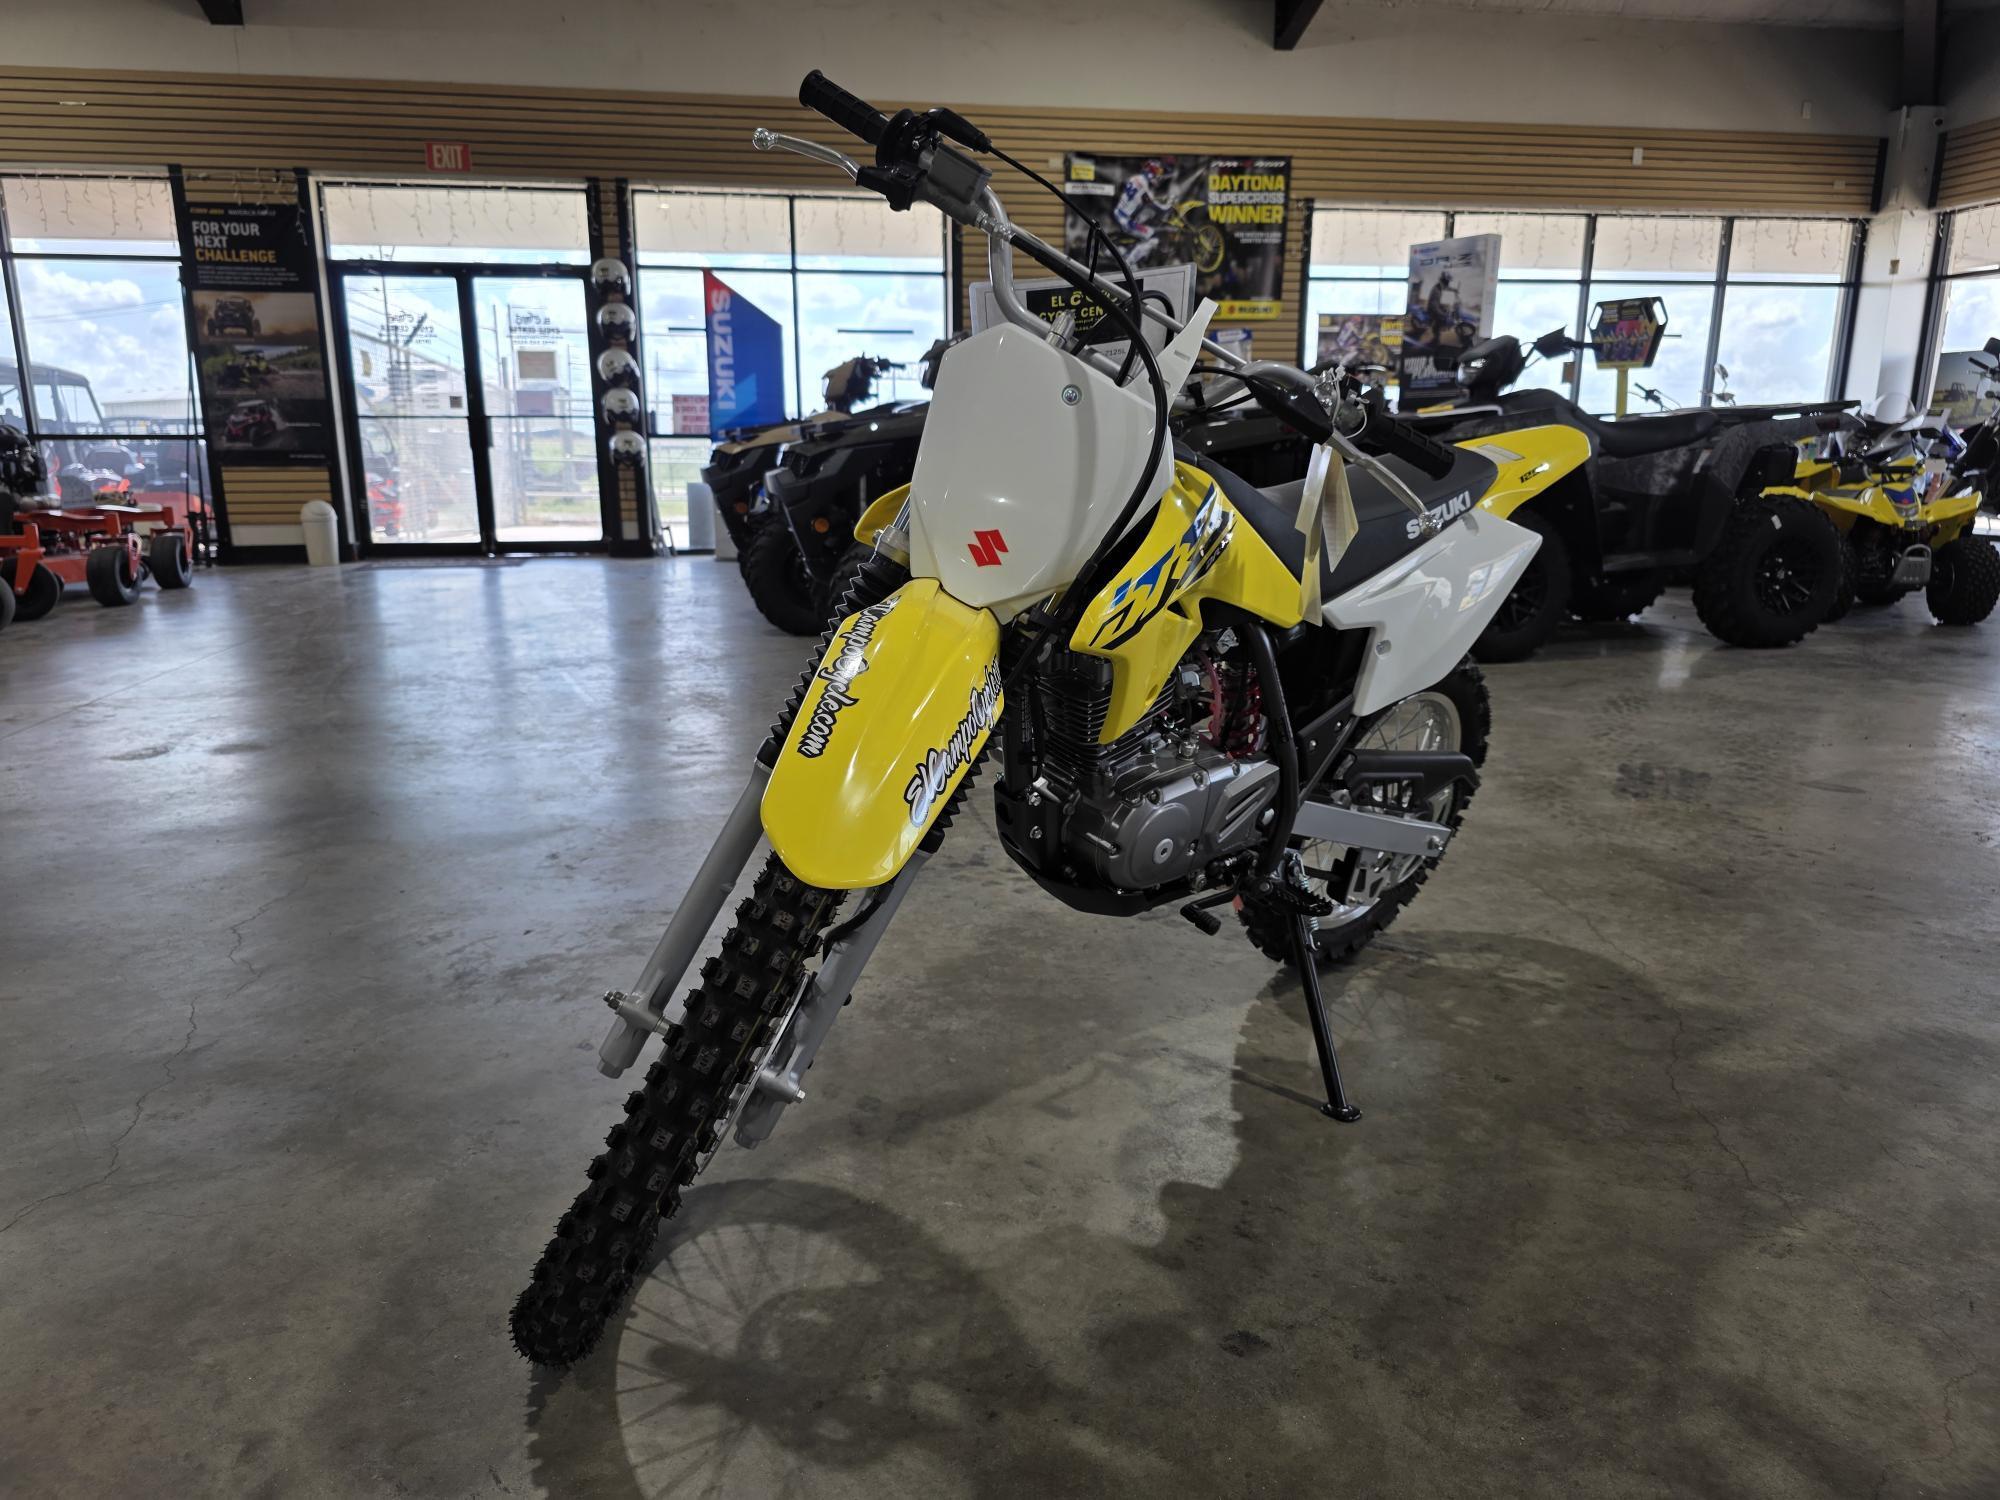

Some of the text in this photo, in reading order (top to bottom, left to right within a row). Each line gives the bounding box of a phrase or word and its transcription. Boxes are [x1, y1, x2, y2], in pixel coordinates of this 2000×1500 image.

[432, 145, 463, 169] EXIT
[1208, 175, 1285, 192] DAYTONA
[1208, 192, 1285, 205] SUPERCROSS
[1208, 205, 1284, 224] WINNER
[192, 221, 260, 236] FOR YOUR
[193, 235, 228, 248] NEXT
[195, 248, 277, 263] CHALLENGE
[1051, 295, 1065, 308] EL
[711, 288, 737, 410] SUZUKI
[1406, 490, 1471, 540] SZUKI
